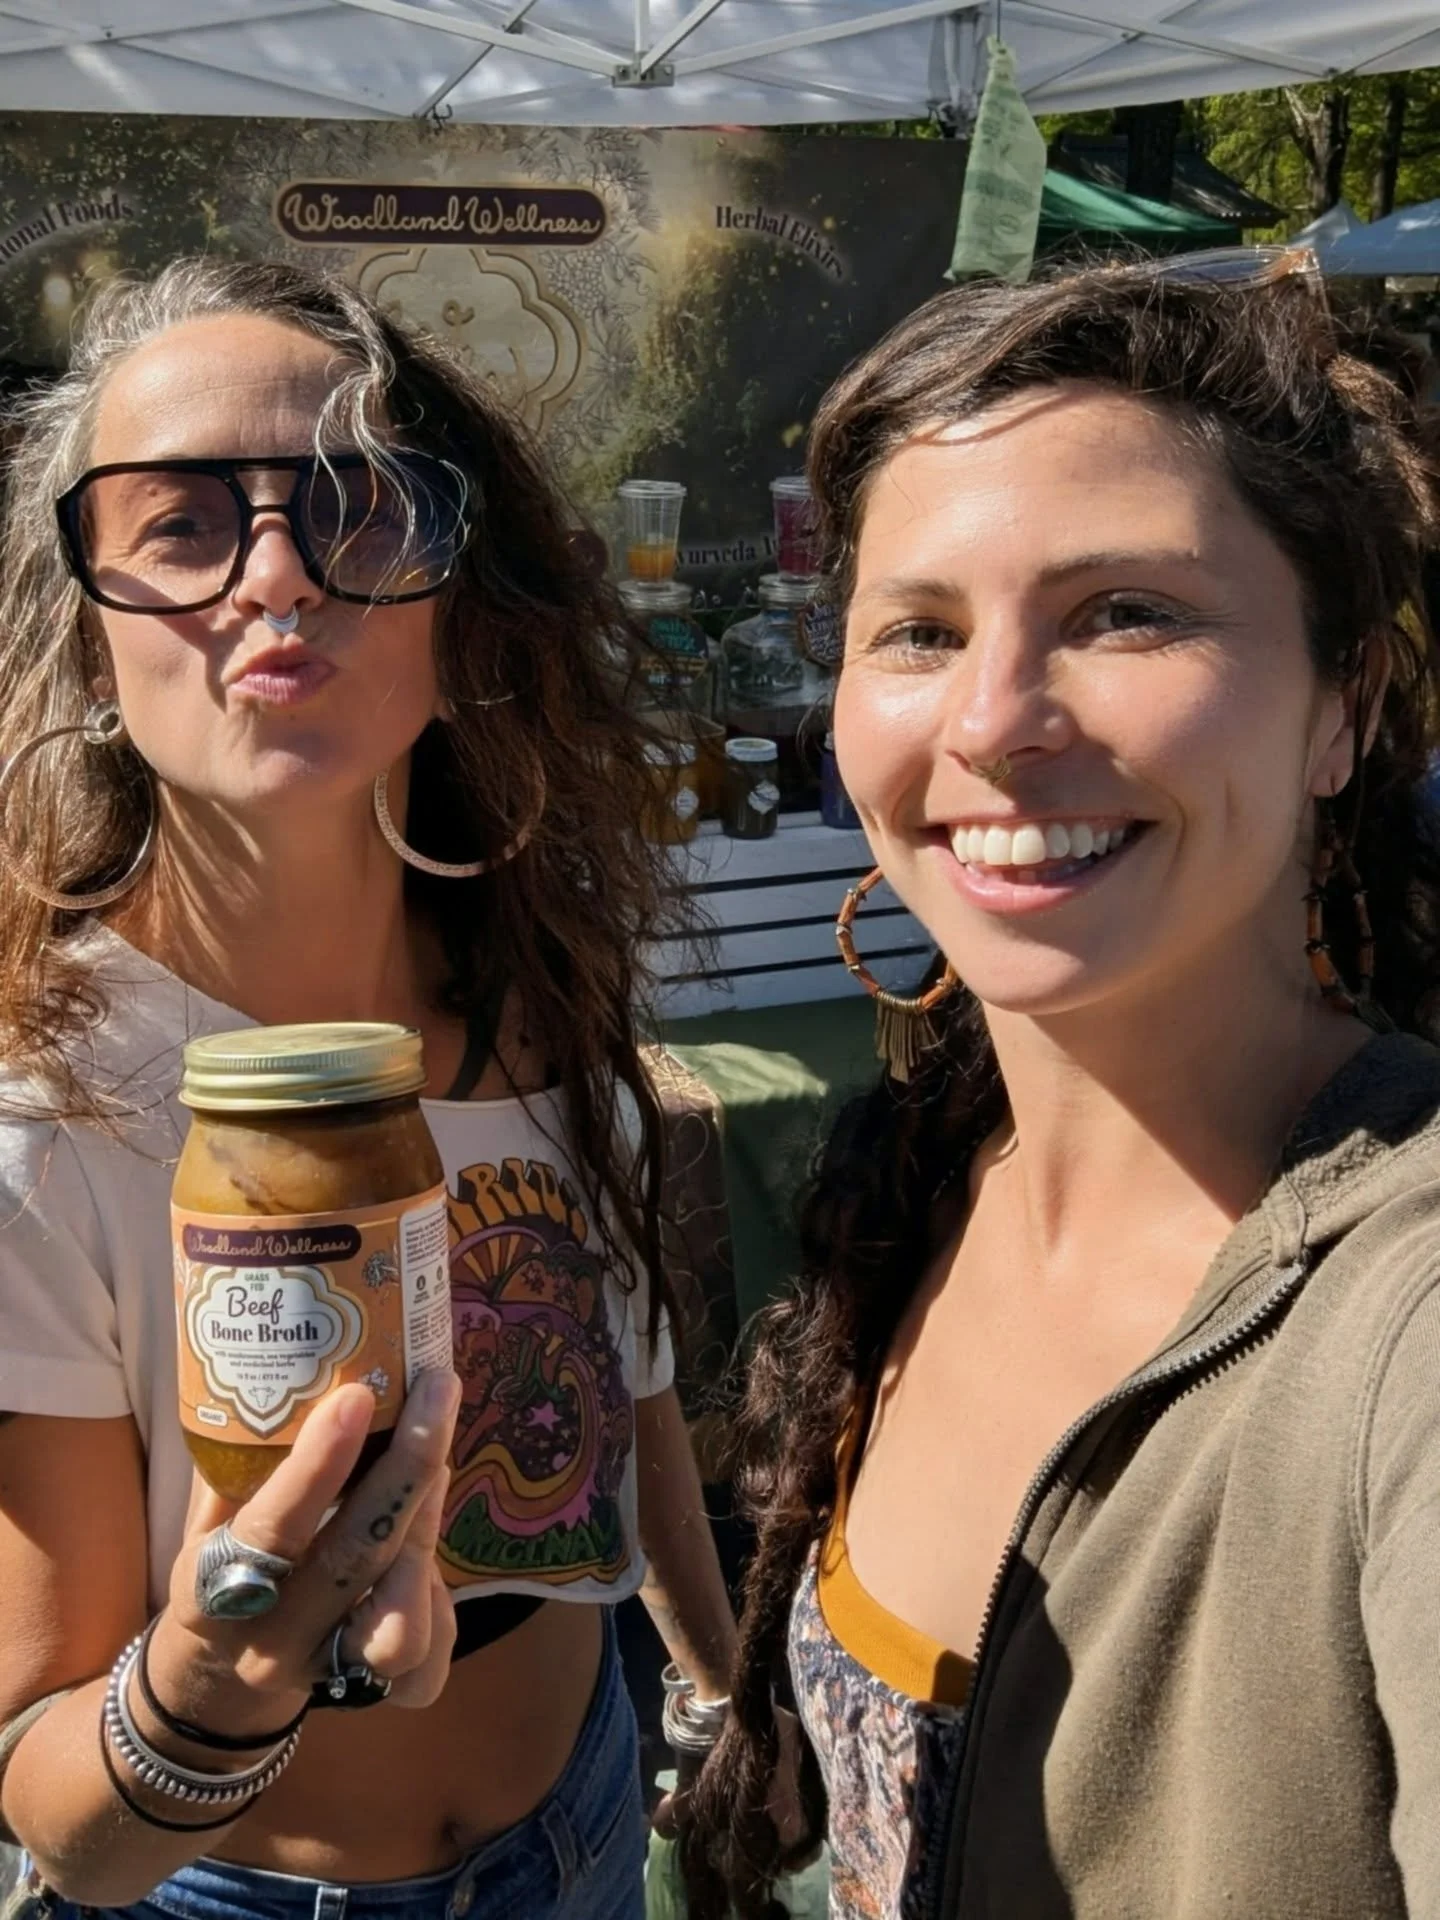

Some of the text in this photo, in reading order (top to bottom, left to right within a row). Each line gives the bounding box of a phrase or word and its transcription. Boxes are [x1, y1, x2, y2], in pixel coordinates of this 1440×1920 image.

[0, 191, 134, 265] ional Foods
[284, 193, 599, 235] Woodland Wellness
[716, 205, 843, 279] Herbal Elixirs
[676, 540, 756, 568] yurveda
[190, 1233, 352, 1257] Woodland Wellness
[244, 1273, 270, 1282] GRASS
[250, 1283, 265, 1292] FED
[226, 1286, 284, 1326] Beef
[211, 1319, 319, 1343] Bone Broth
